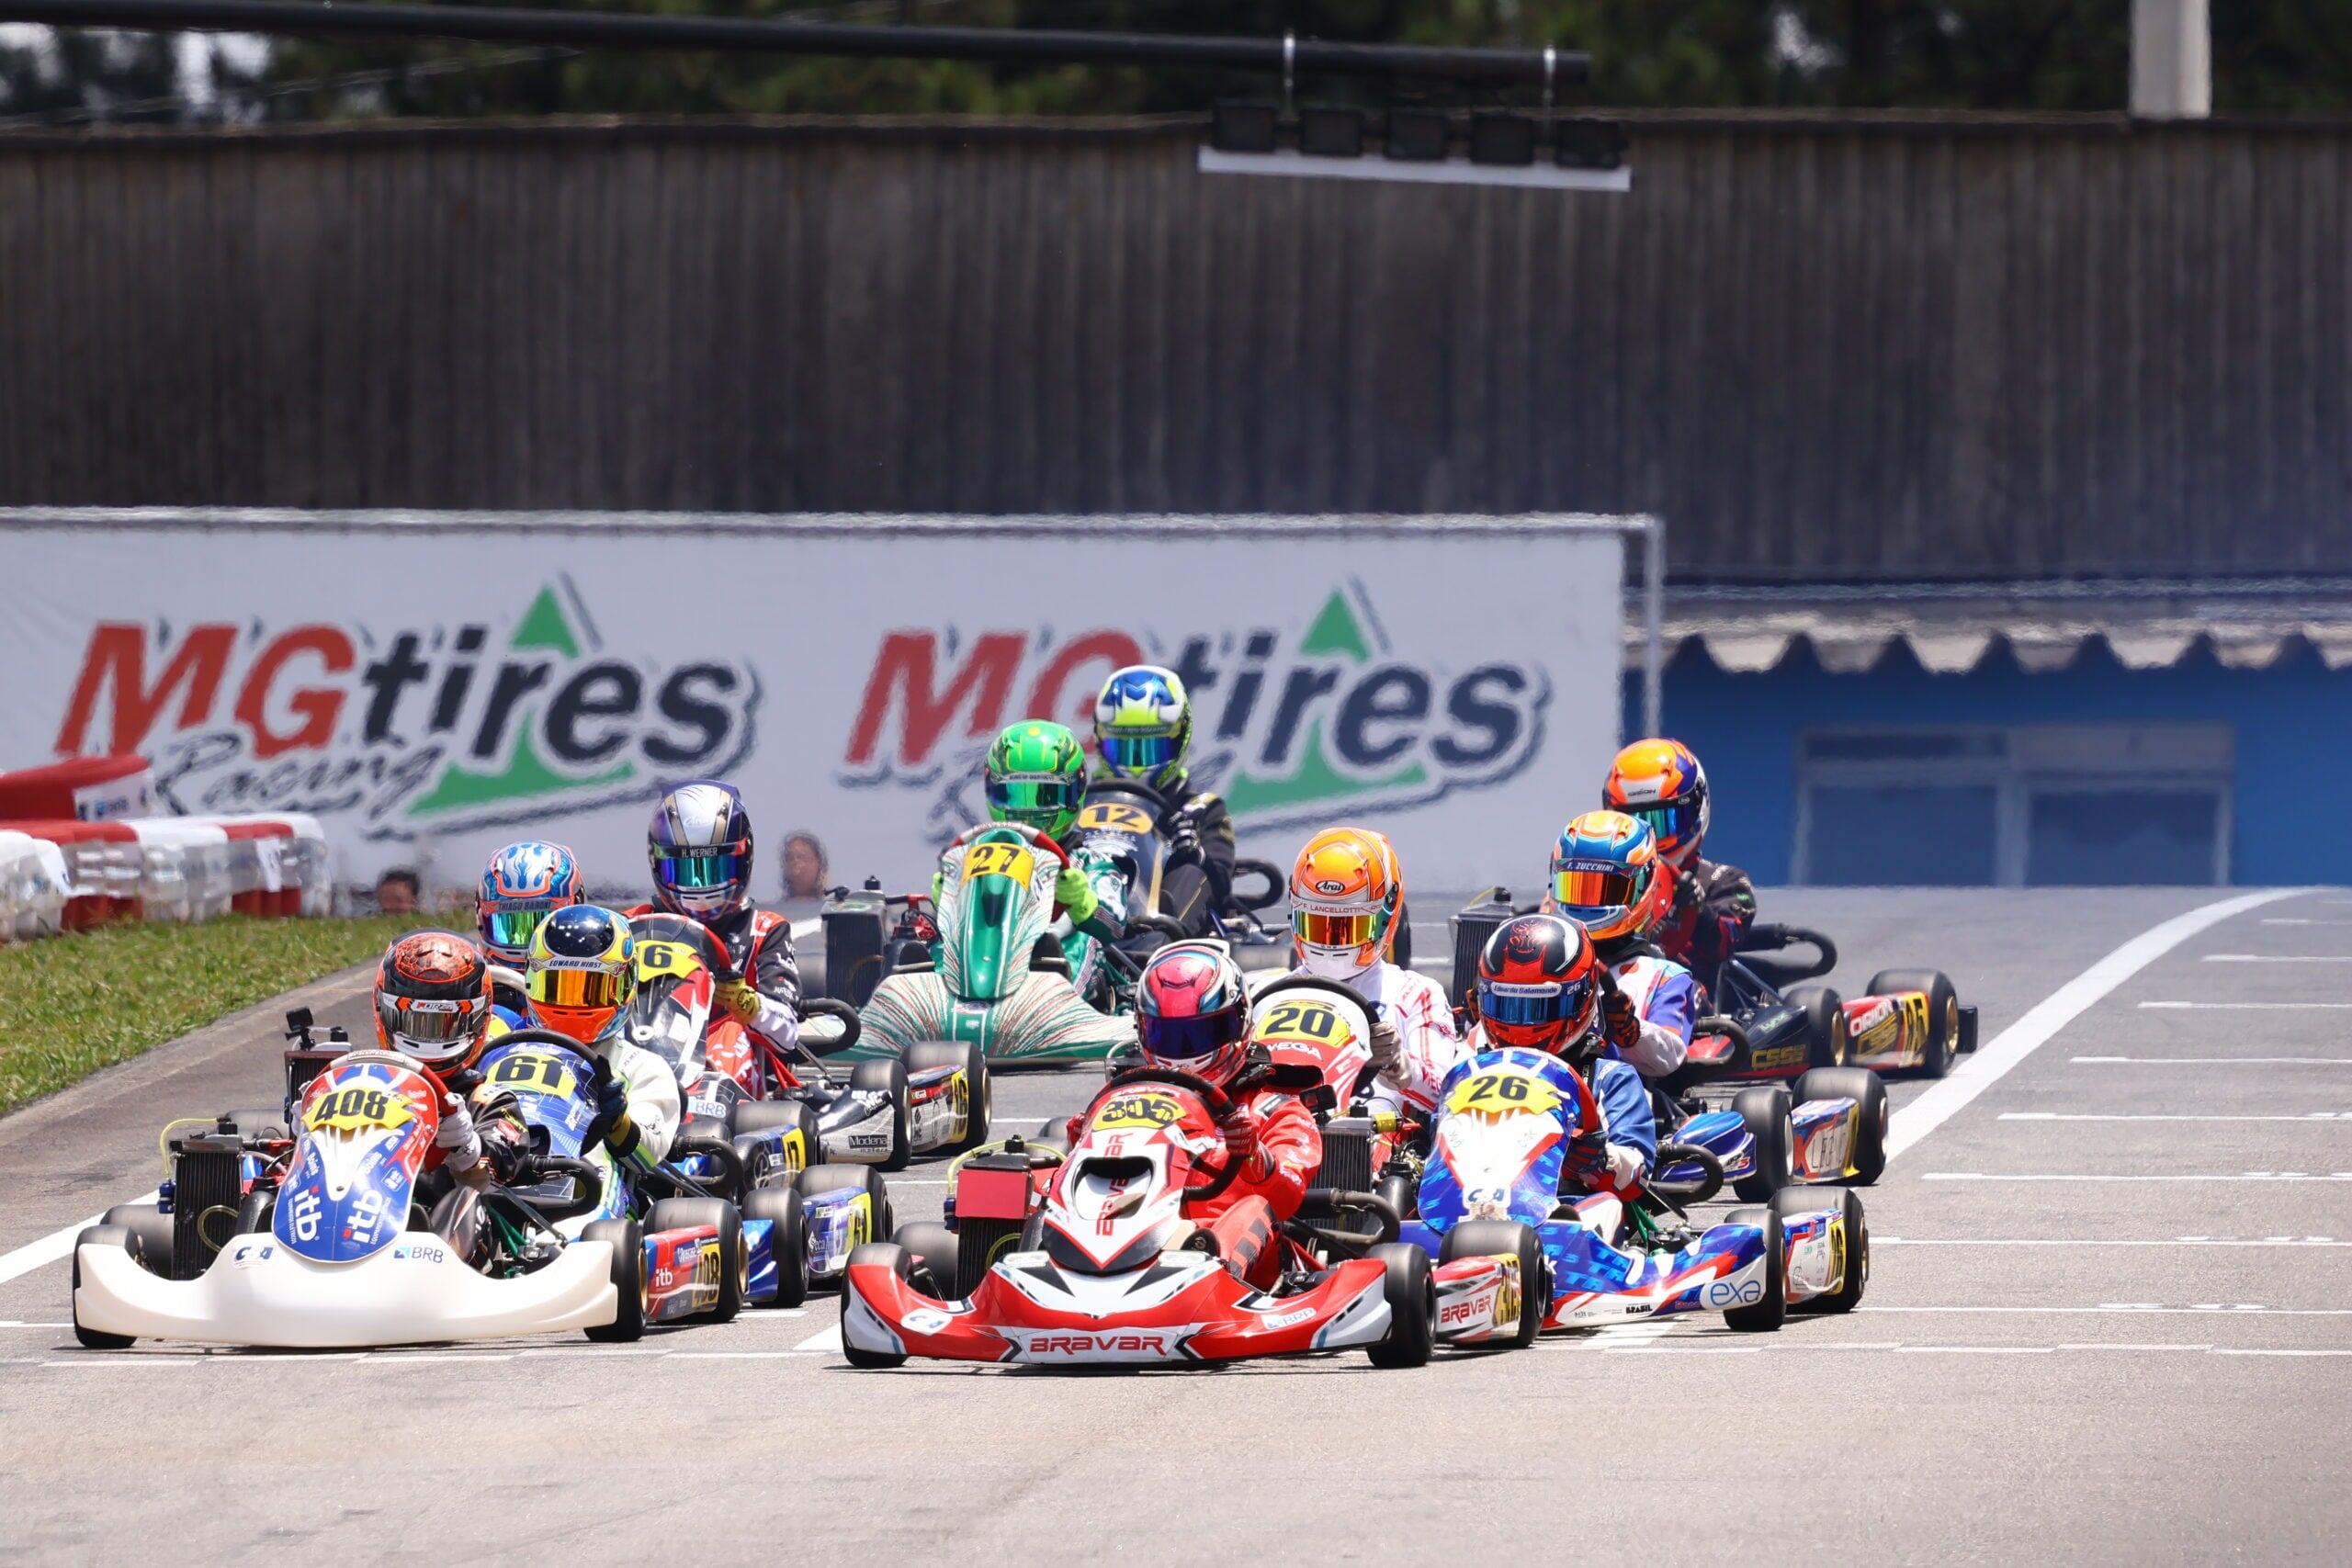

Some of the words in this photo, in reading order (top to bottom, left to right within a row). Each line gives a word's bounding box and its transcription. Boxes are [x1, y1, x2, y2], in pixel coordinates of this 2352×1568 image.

[54, 622, 738, 763] MGtires
[1089, 806, 1143, 828] 12
[682, 849, 688, 858] H.
[689, 847, 718, 858] WERNER
[970, 846, 1020, 874] 27
[1318, 881, 1342, 892] Arai
[498, 902, 523, 910] THIAGO
[1310, 905, 1361, 914] LANCELLOTTI
[581, 961, 603, 969] HIRST
[1566, 981, 1581, 996] 26
[1264, 1007, 1336, 1038] 20
[494, 1055, 565, 1089] 61
[1467, 1076, 1530, 1103] 26
[313, 1089, 390, 1123] 408
[695, 1102, 726, 1117] BRB
[1102, 1098, 1180, 1126] 305
[850, 1135, 888, 1146] Modena
[1467, 1188, 1505, 1202] CA
[294, 1185, 322, 1241] itb
[343, 1189, 383, 1244] itb
[235, 1246, 274, 1261] CA
[411, 1247, 445, 1264] BRB
[655, 1268, 673, 1287] itb
[1710, 1280, 1761, 1307] exa
